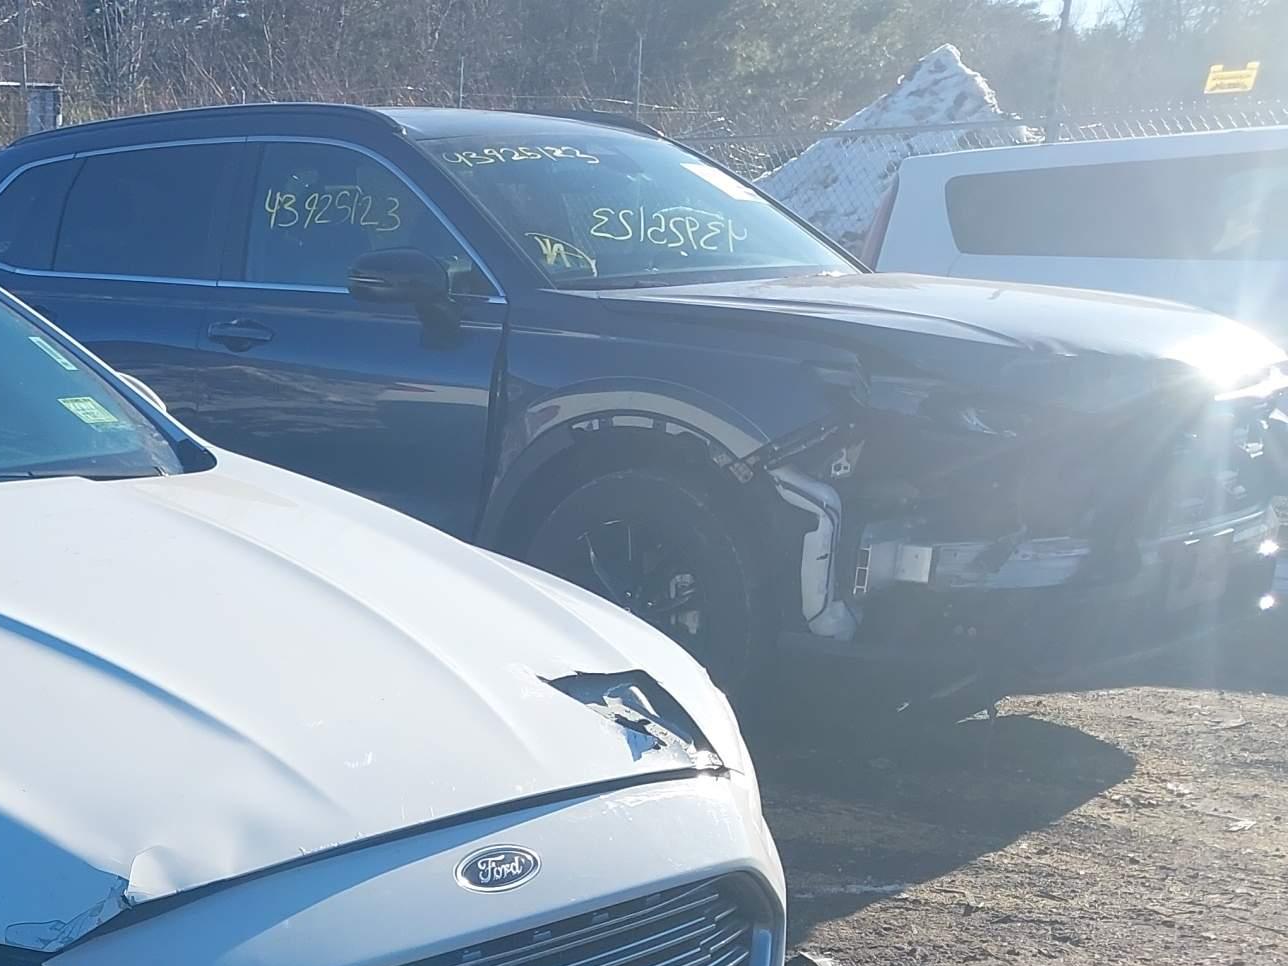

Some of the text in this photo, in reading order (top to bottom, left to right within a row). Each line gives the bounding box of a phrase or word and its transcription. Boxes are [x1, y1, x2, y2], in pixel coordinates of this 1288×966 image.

[443, 146, 600, 167] 43925123
[265, 188, 401, 231] 43925123
[478, 854, 525, 883] Ford
